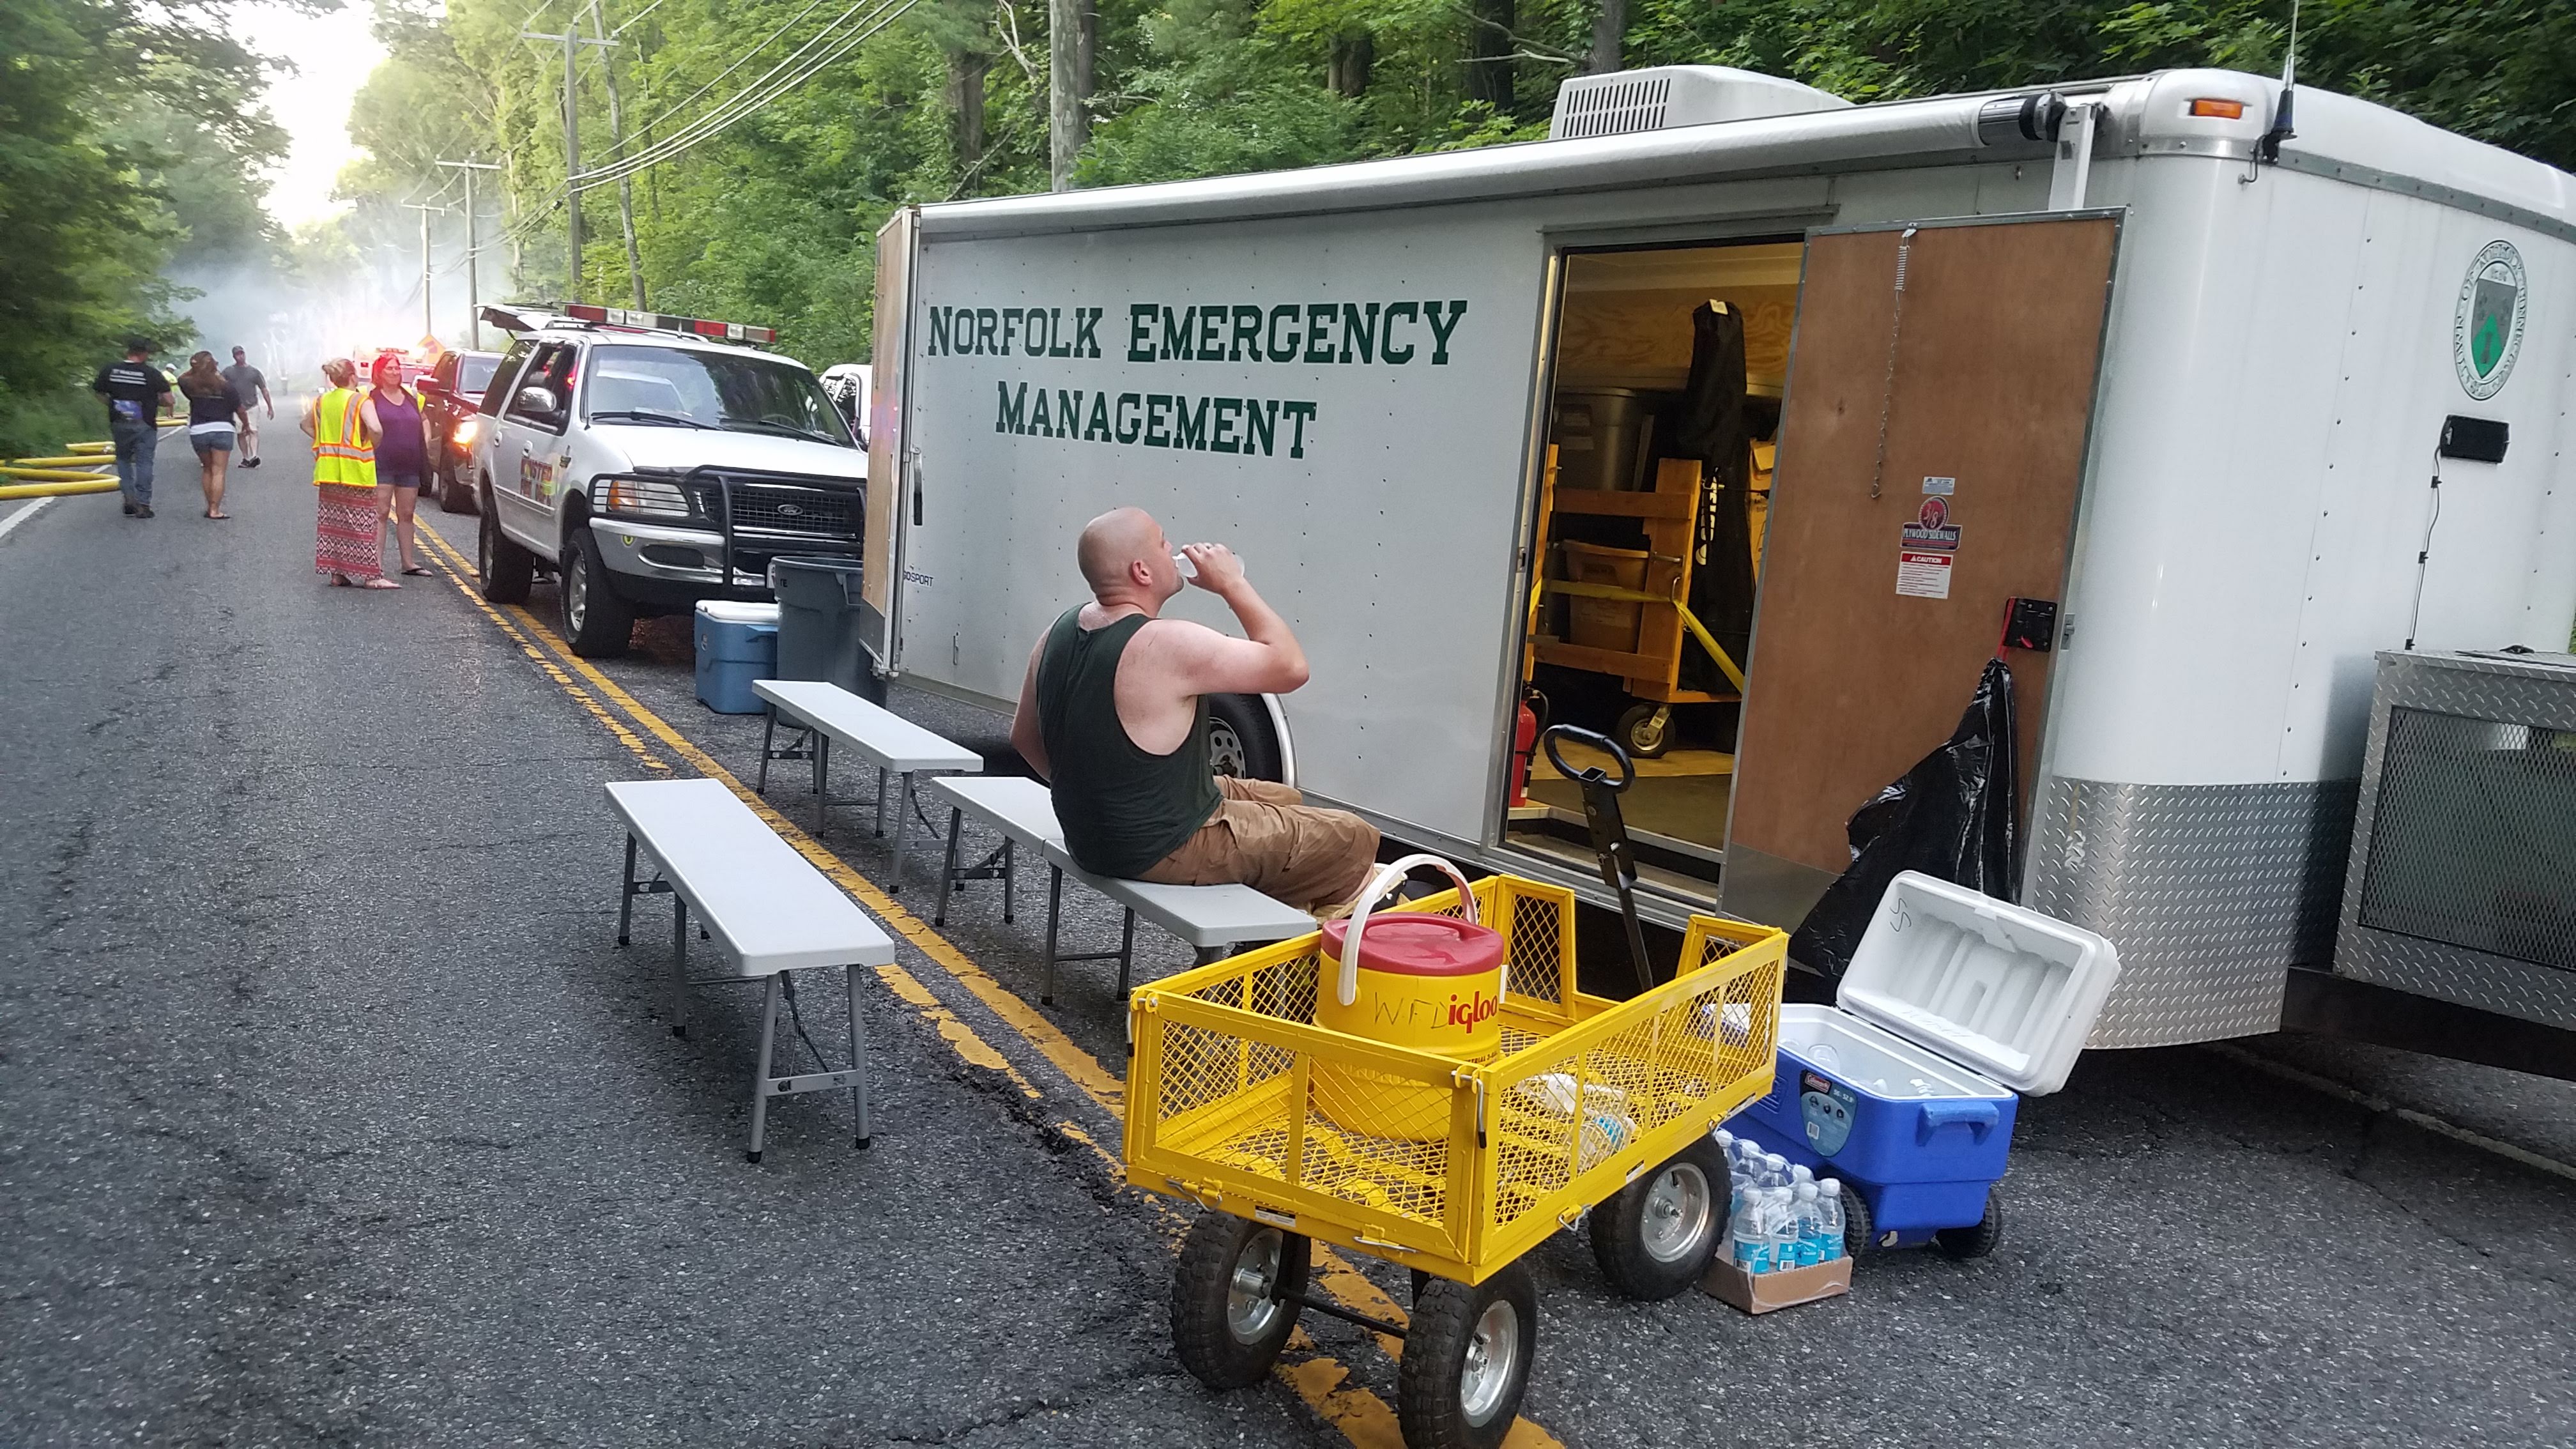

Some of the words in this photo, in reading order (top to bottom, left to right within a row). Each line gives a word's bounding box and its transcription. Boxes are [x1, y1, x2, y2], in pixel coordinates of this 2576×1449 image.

[928, 307, 1102, 358] NORFOLK
[1128, 300, 1468, 364] EMERGENCY
[996, 381, 1317, 459] MANAGEMENT
[1903, 528, 1928, 539] PLYWOOD
[1928, 530, 1956, 540] SIDEWALLS
[1448, 990, 1498, 1034] igloo
